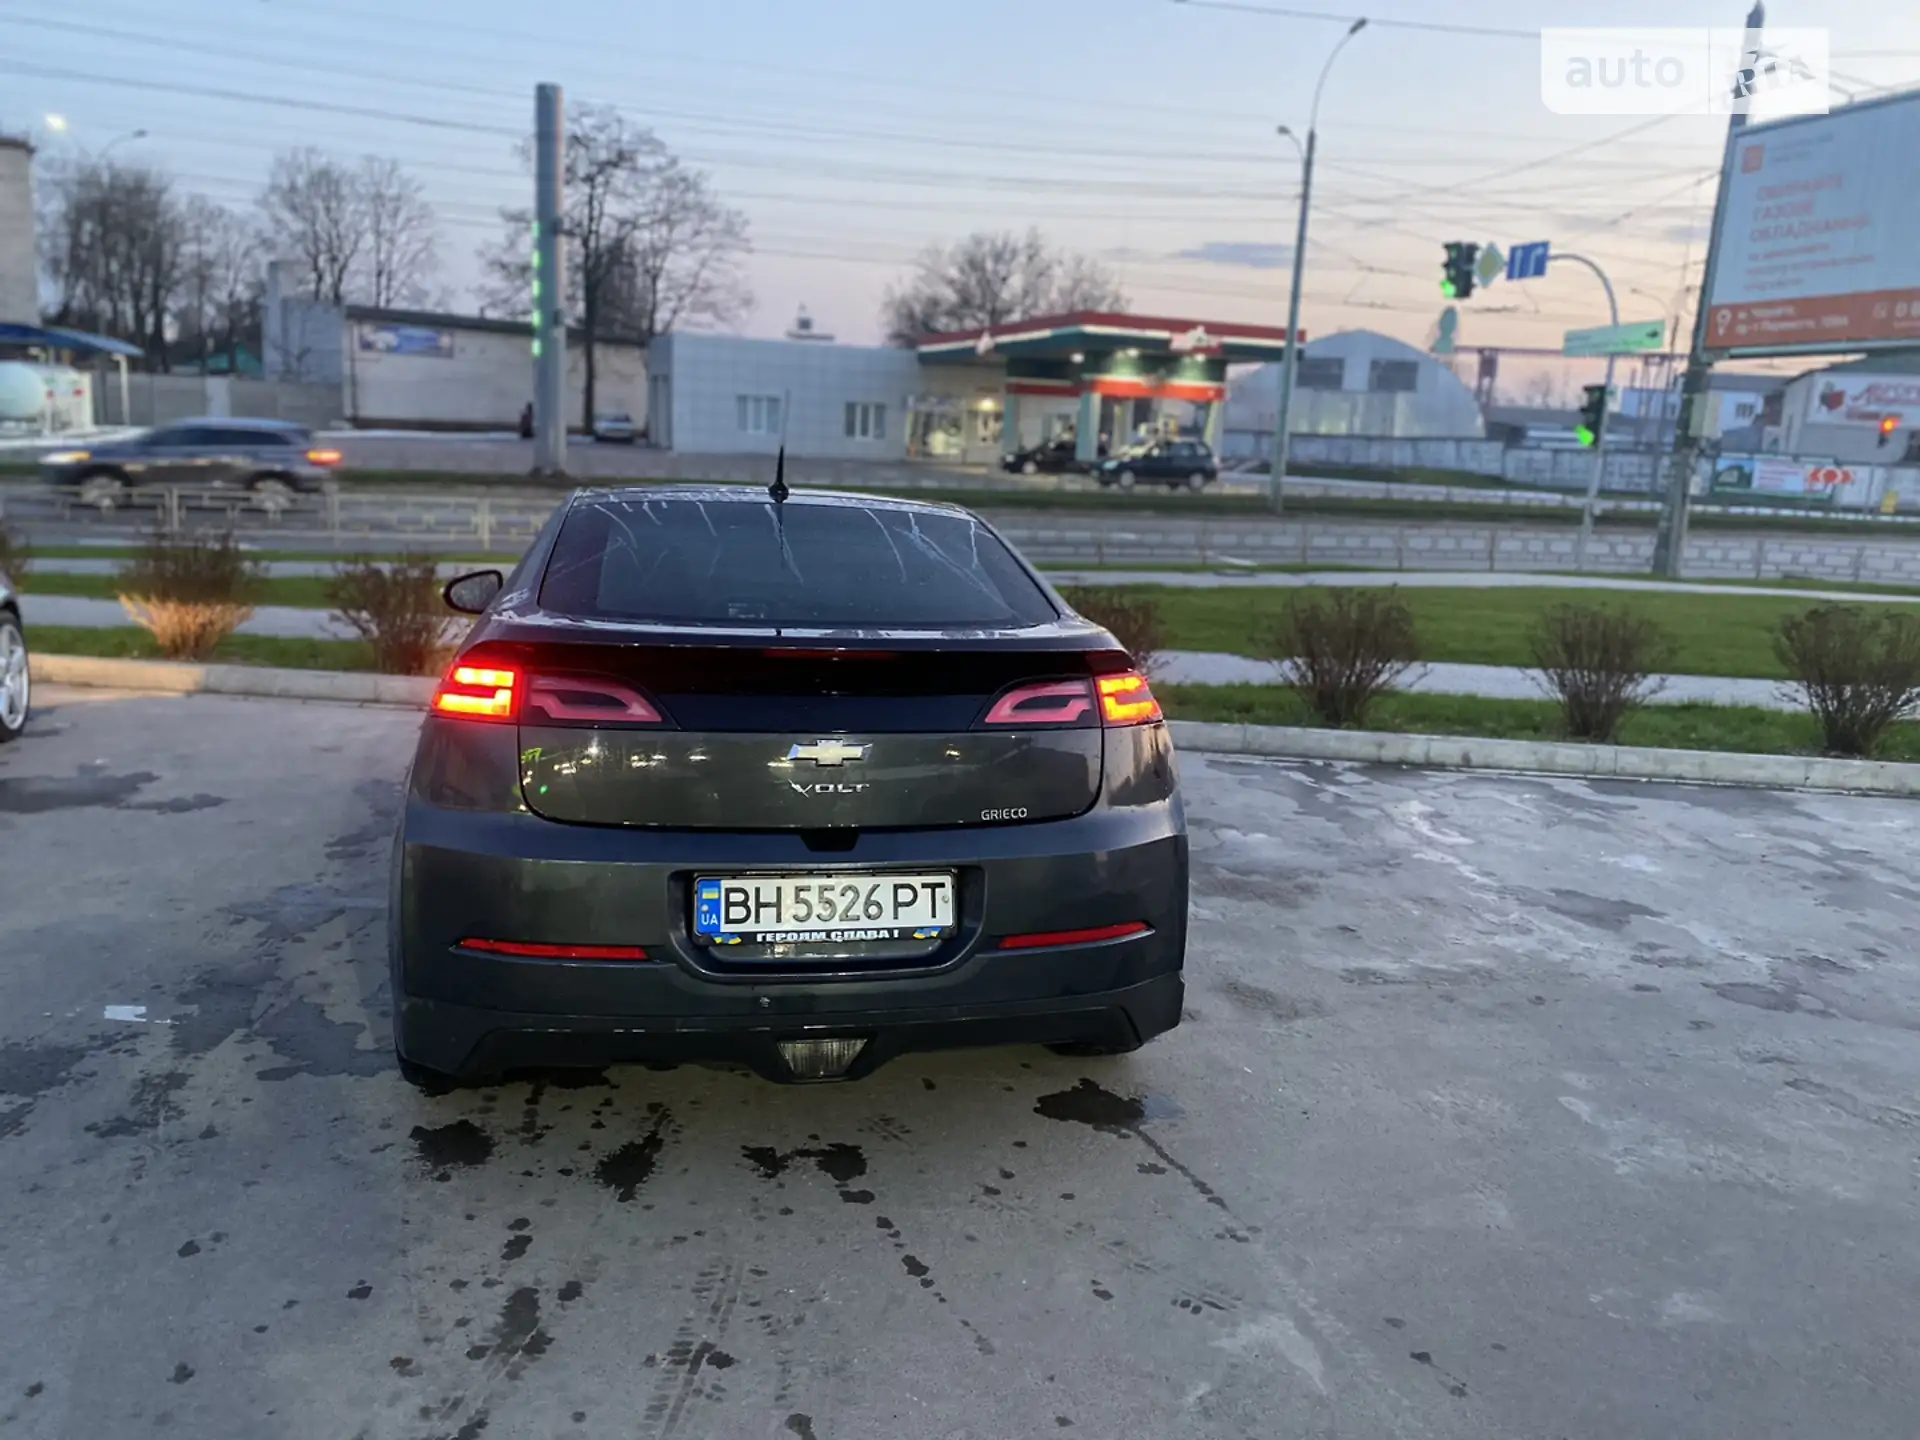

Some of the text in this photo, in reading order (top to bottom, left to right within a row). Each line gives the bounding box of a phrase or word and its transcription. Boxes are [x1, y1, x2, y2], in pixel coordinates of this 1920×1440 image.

[788, 779, 870, 797] VOLT
[981, 807, 1028, 821] GRIECO
[724, 882, 946, 924] BH 5526 PT
[701, 913, 719, 925] UA
[756, 931, 826, 942] ГЕРОЯМ
